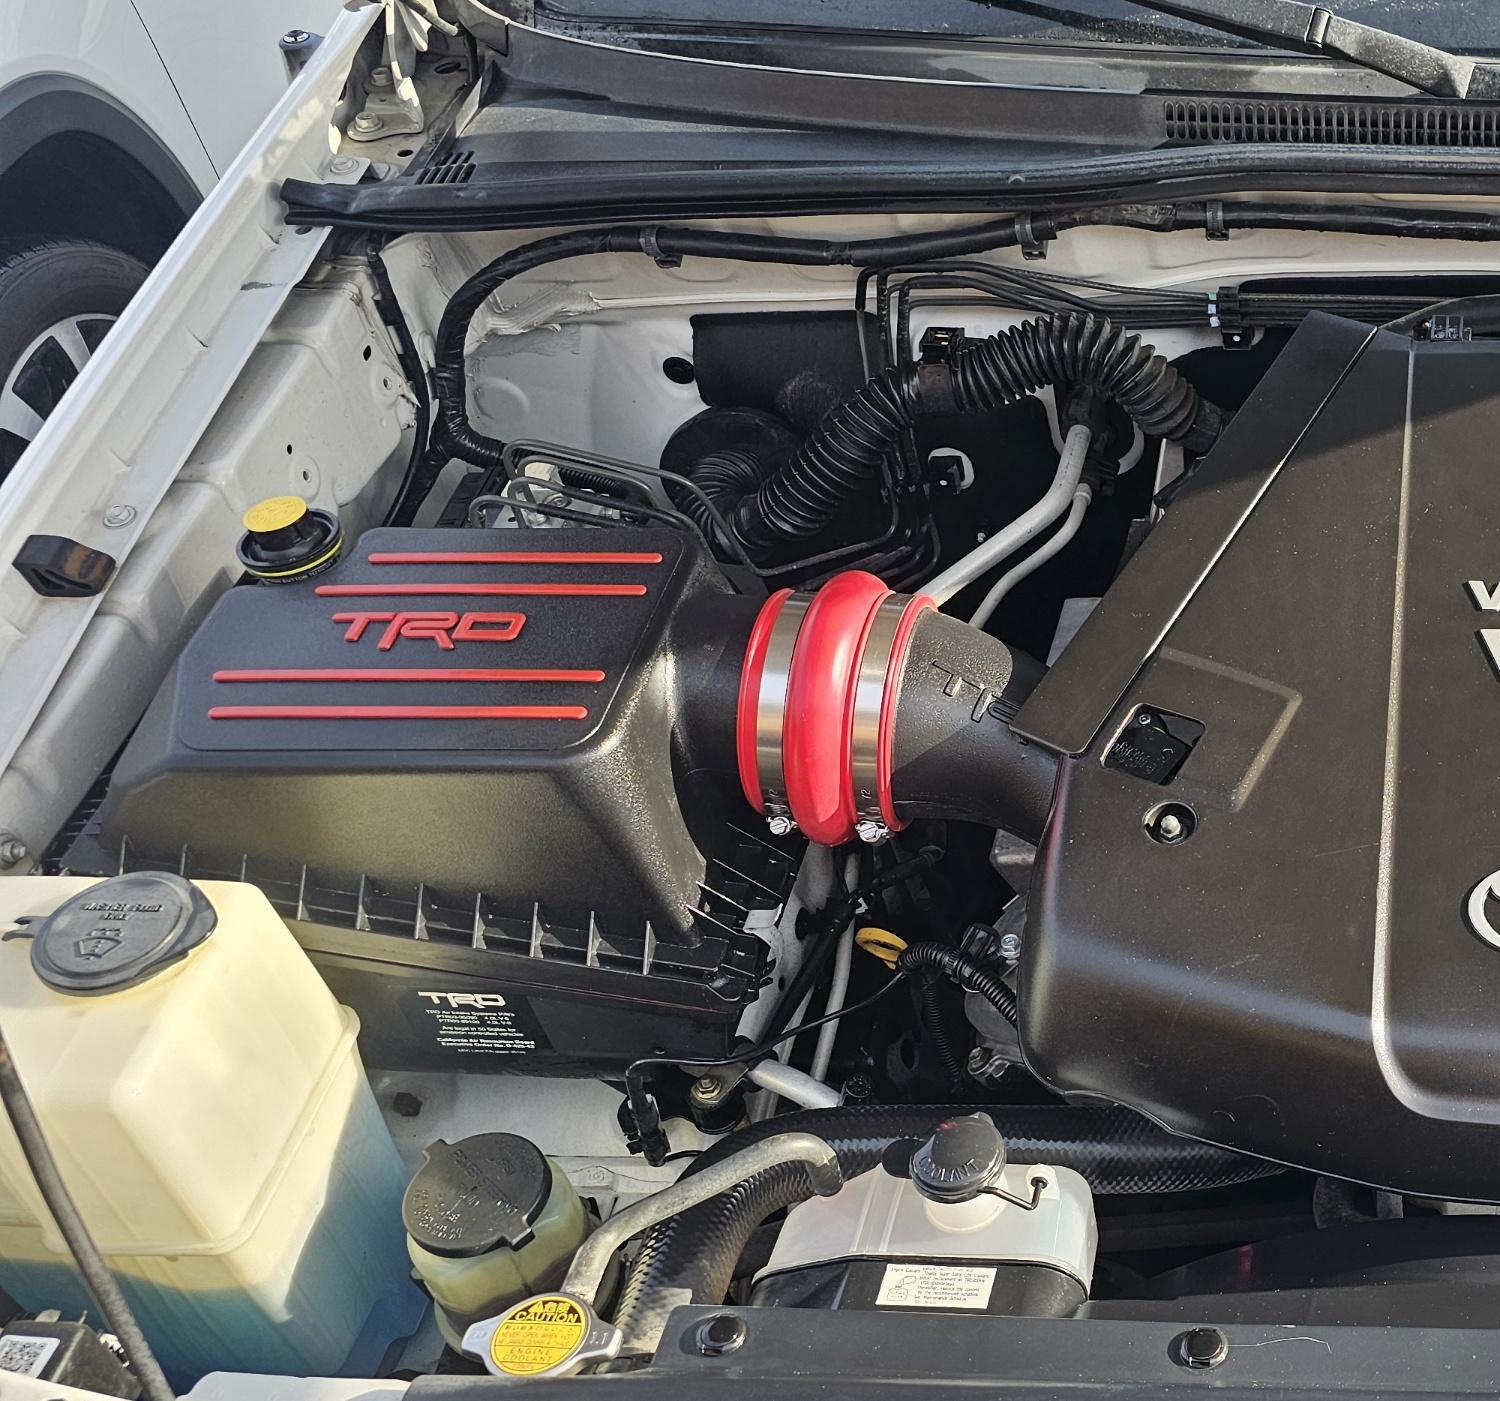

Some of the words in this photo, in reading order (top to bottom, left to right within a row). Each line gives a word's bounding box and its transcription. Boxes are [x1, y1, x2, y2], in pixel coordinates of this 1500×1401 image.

[331, 611, 527, 650] TRD
[932, 660, 1019, 723] TR
[418, 991, 506, 1008] TRD
[918, 1156, 979, 1183] COOLANT
[453, 1149, 483, 1180] POWER
[479, 1176, 518, 1217] STEERING
[515, 1311, 578, 1323] CAUTION
[502, 1354, 554, 1362] COOLANT
[510, 1348, 551, 1356] ENGINE
